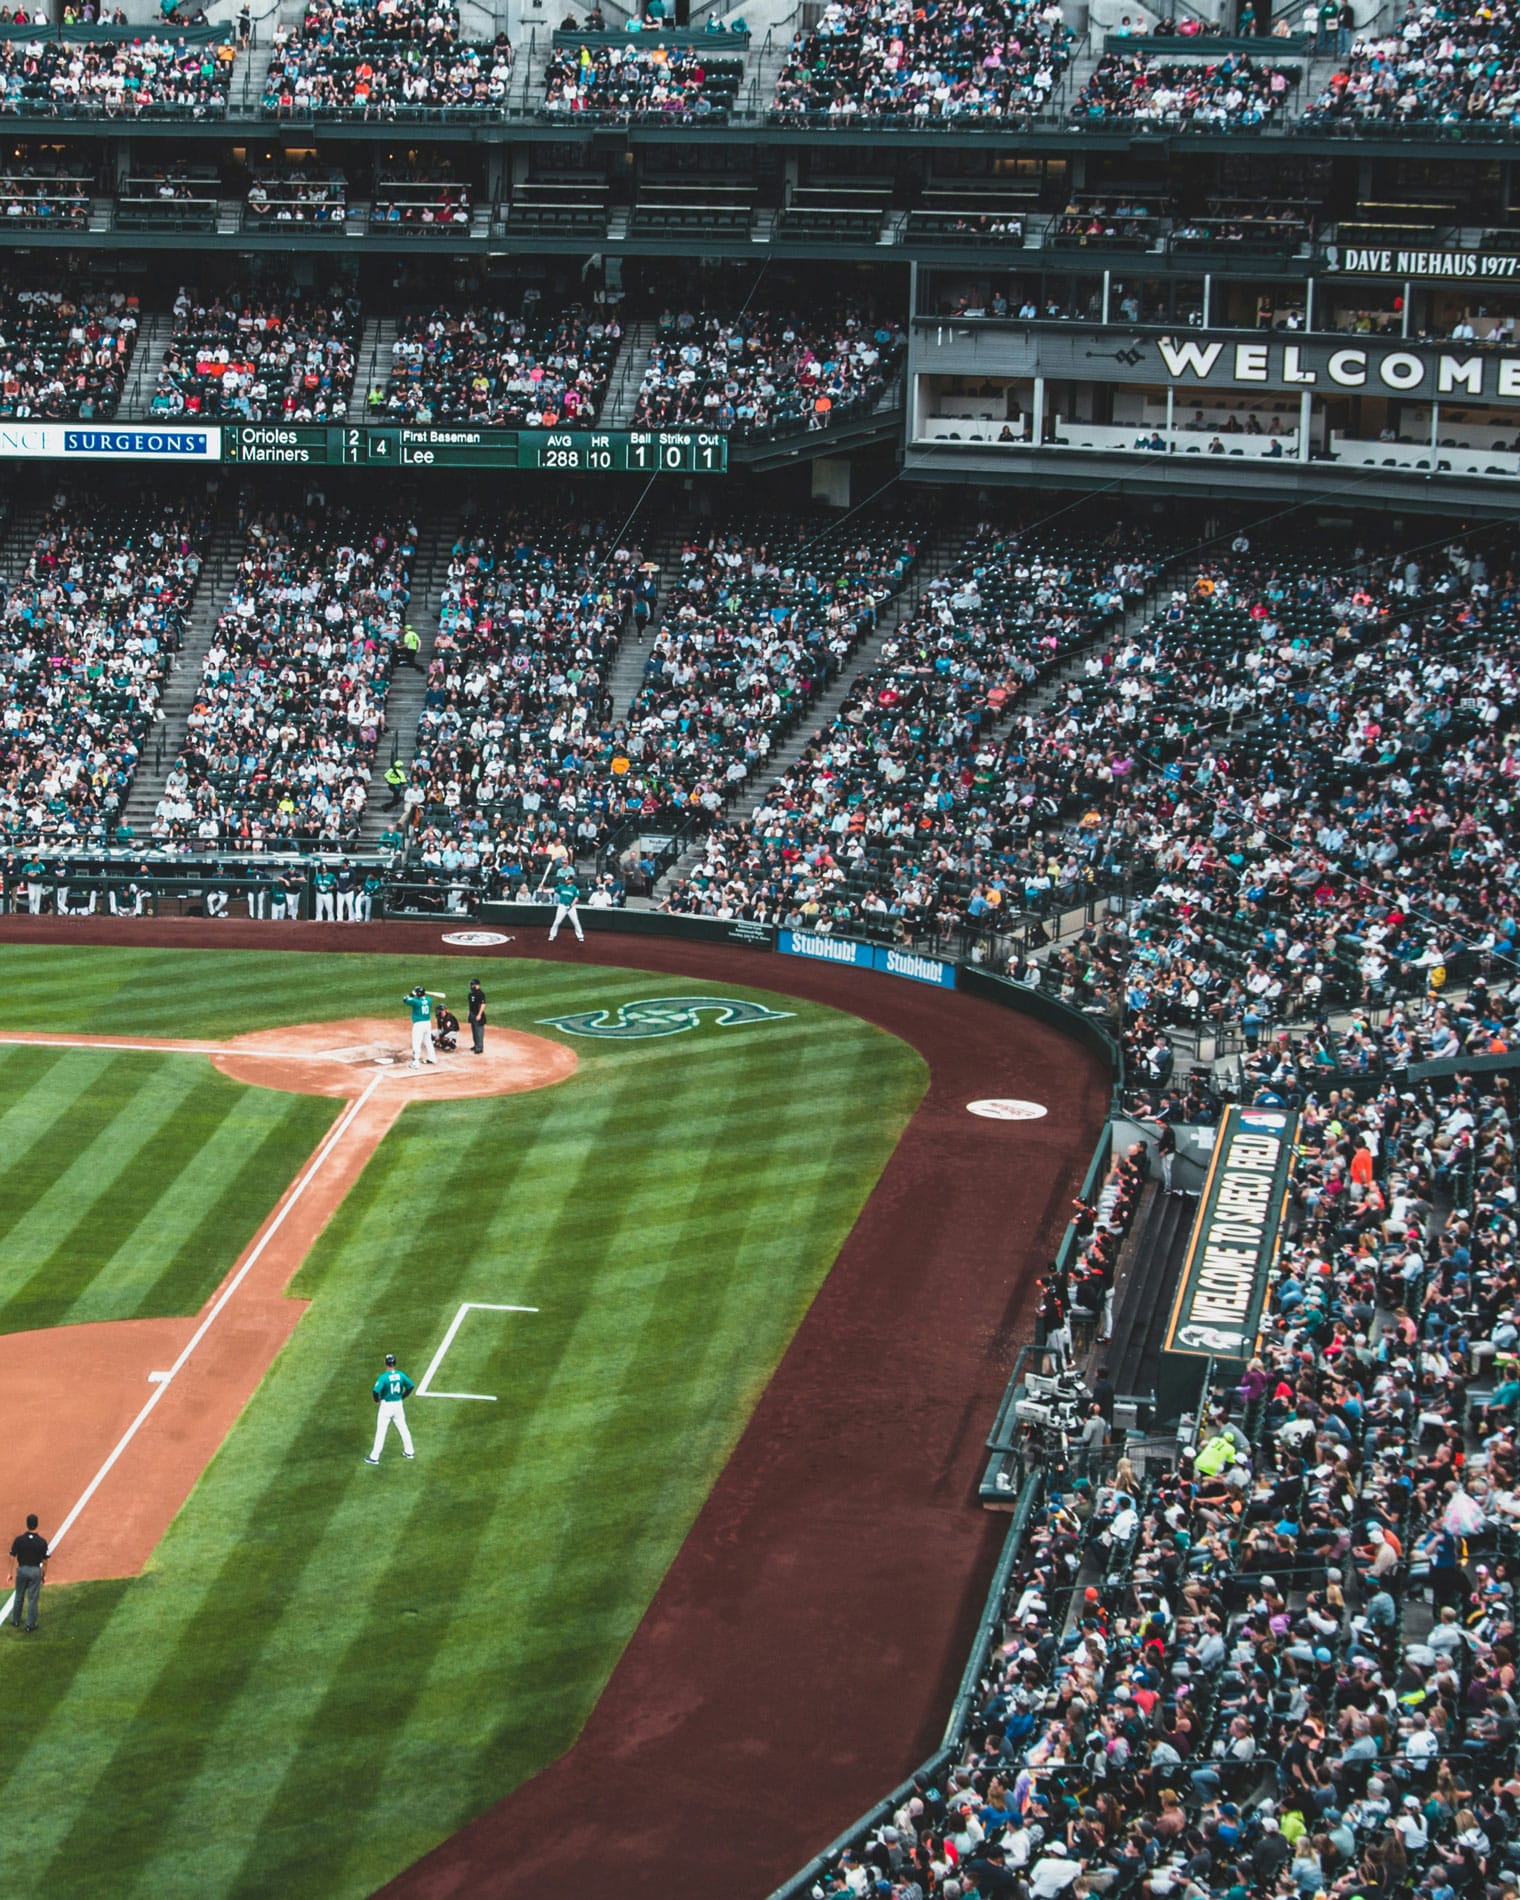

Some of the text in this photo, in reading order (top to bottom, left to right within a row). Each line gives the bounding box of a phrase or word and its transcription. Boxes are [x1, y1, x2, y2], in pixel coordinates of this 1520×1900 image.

[1345, 249, 1392, 272] DAVE
[1396, 251, 1477, 276] NIEHAUS
[1156, 337, 1520, 396] WELCOME
[68, 434, 196, 452] SURGEONS
[242, 428, 360, 446] Orioles 2
[402, 431, 481, 444] First Baseman
[547, 435, 610, 448] AVG HR
[630, 432, 719, 446] Ball Strike Out
[242, 445, 358, 463] Mariners 1
[376, 439, 387, 455] 4
[403, 447, 435, 464] Lee
[542, 451, 611, 468] .288 10
[635, 446, 713, 469] 1 0 1
[791, 932, 857, 963] StubHub!
[886, 950, 944, 983] StubHub!
[1189, 1133, 1281, 1324] WELCOME TO SAFECO FIELD
[390, 1381, 401, 1395] 14
